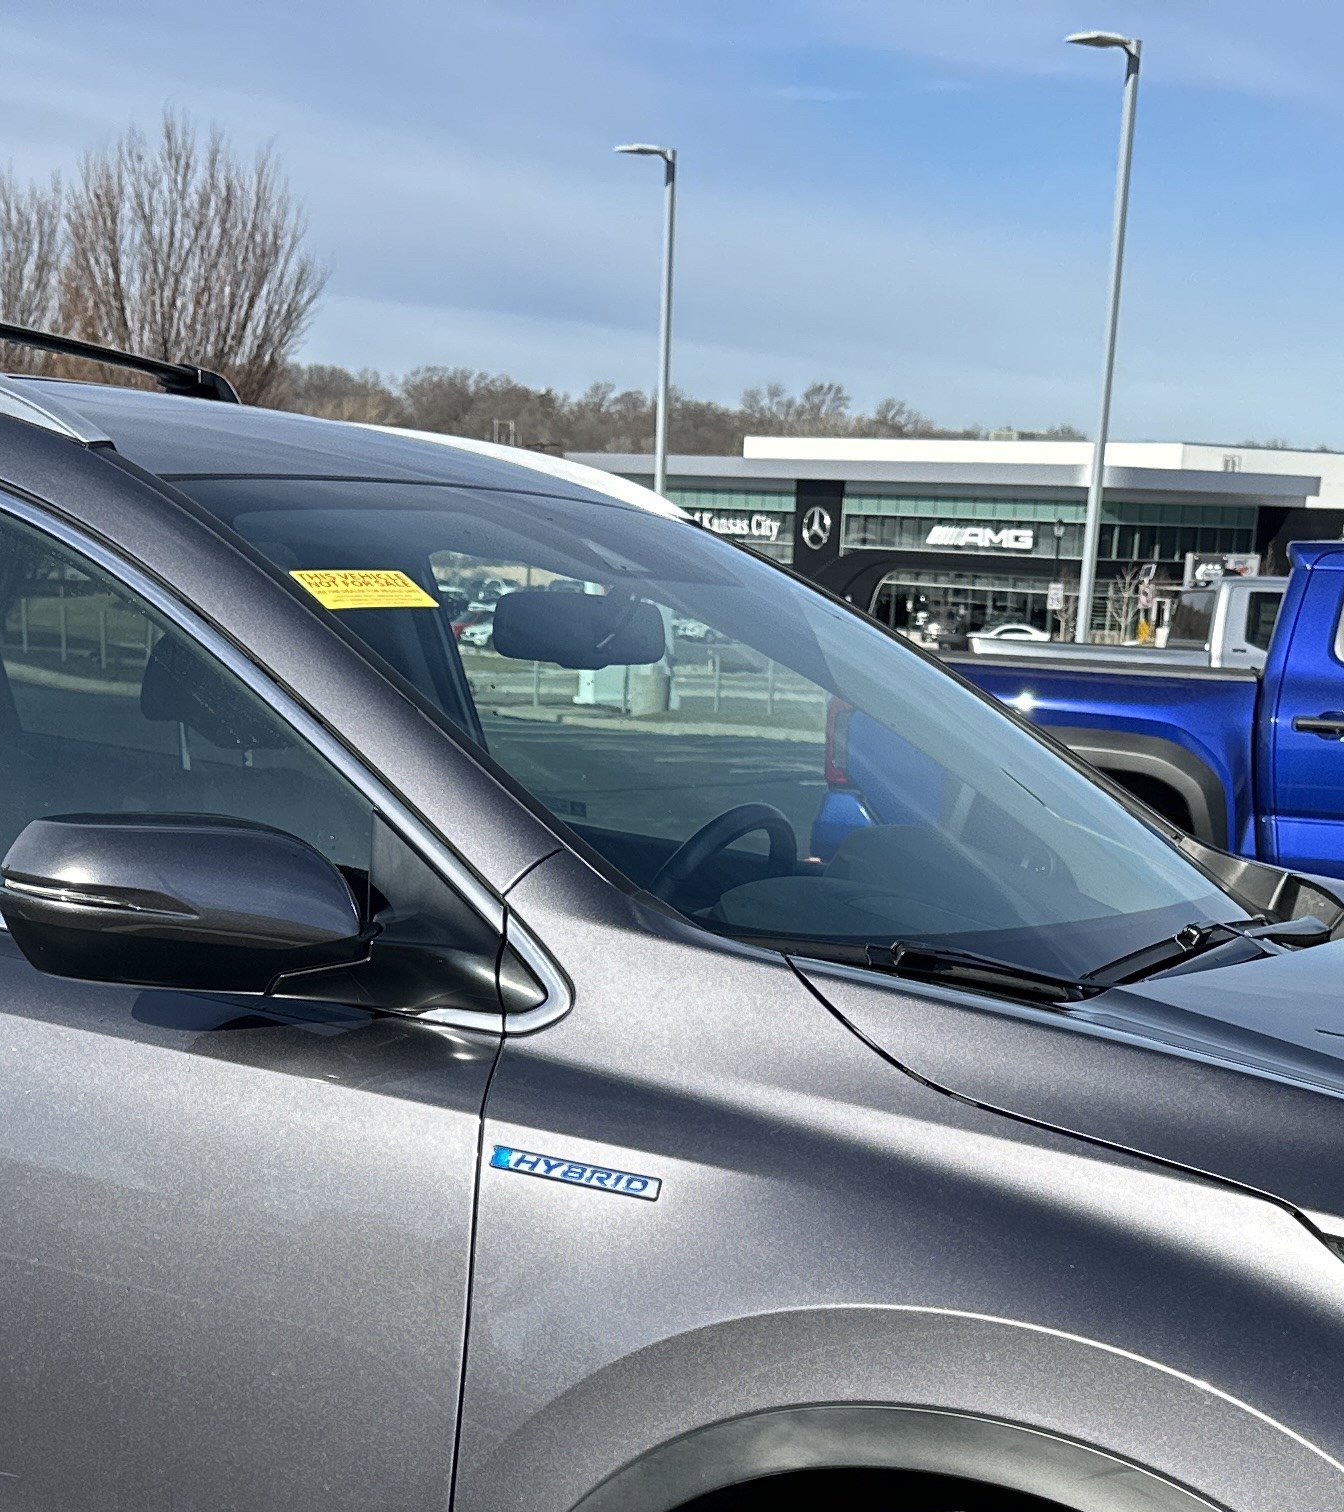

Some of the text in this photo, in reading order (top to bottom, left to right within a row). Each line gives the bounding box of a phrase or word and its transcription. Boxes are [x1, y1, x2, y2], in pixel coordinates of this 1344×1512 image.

[701, 511, 749, 535] Kansas
[751, 513, 781, 541] City
[961, 527, 1034, 549] AMG
[297, 573, 405, 582] THIS VEHICLE
[306, 580, 413, 588] NOT FOR SALE
[512, 1154, 649, 1193] HYBRID
